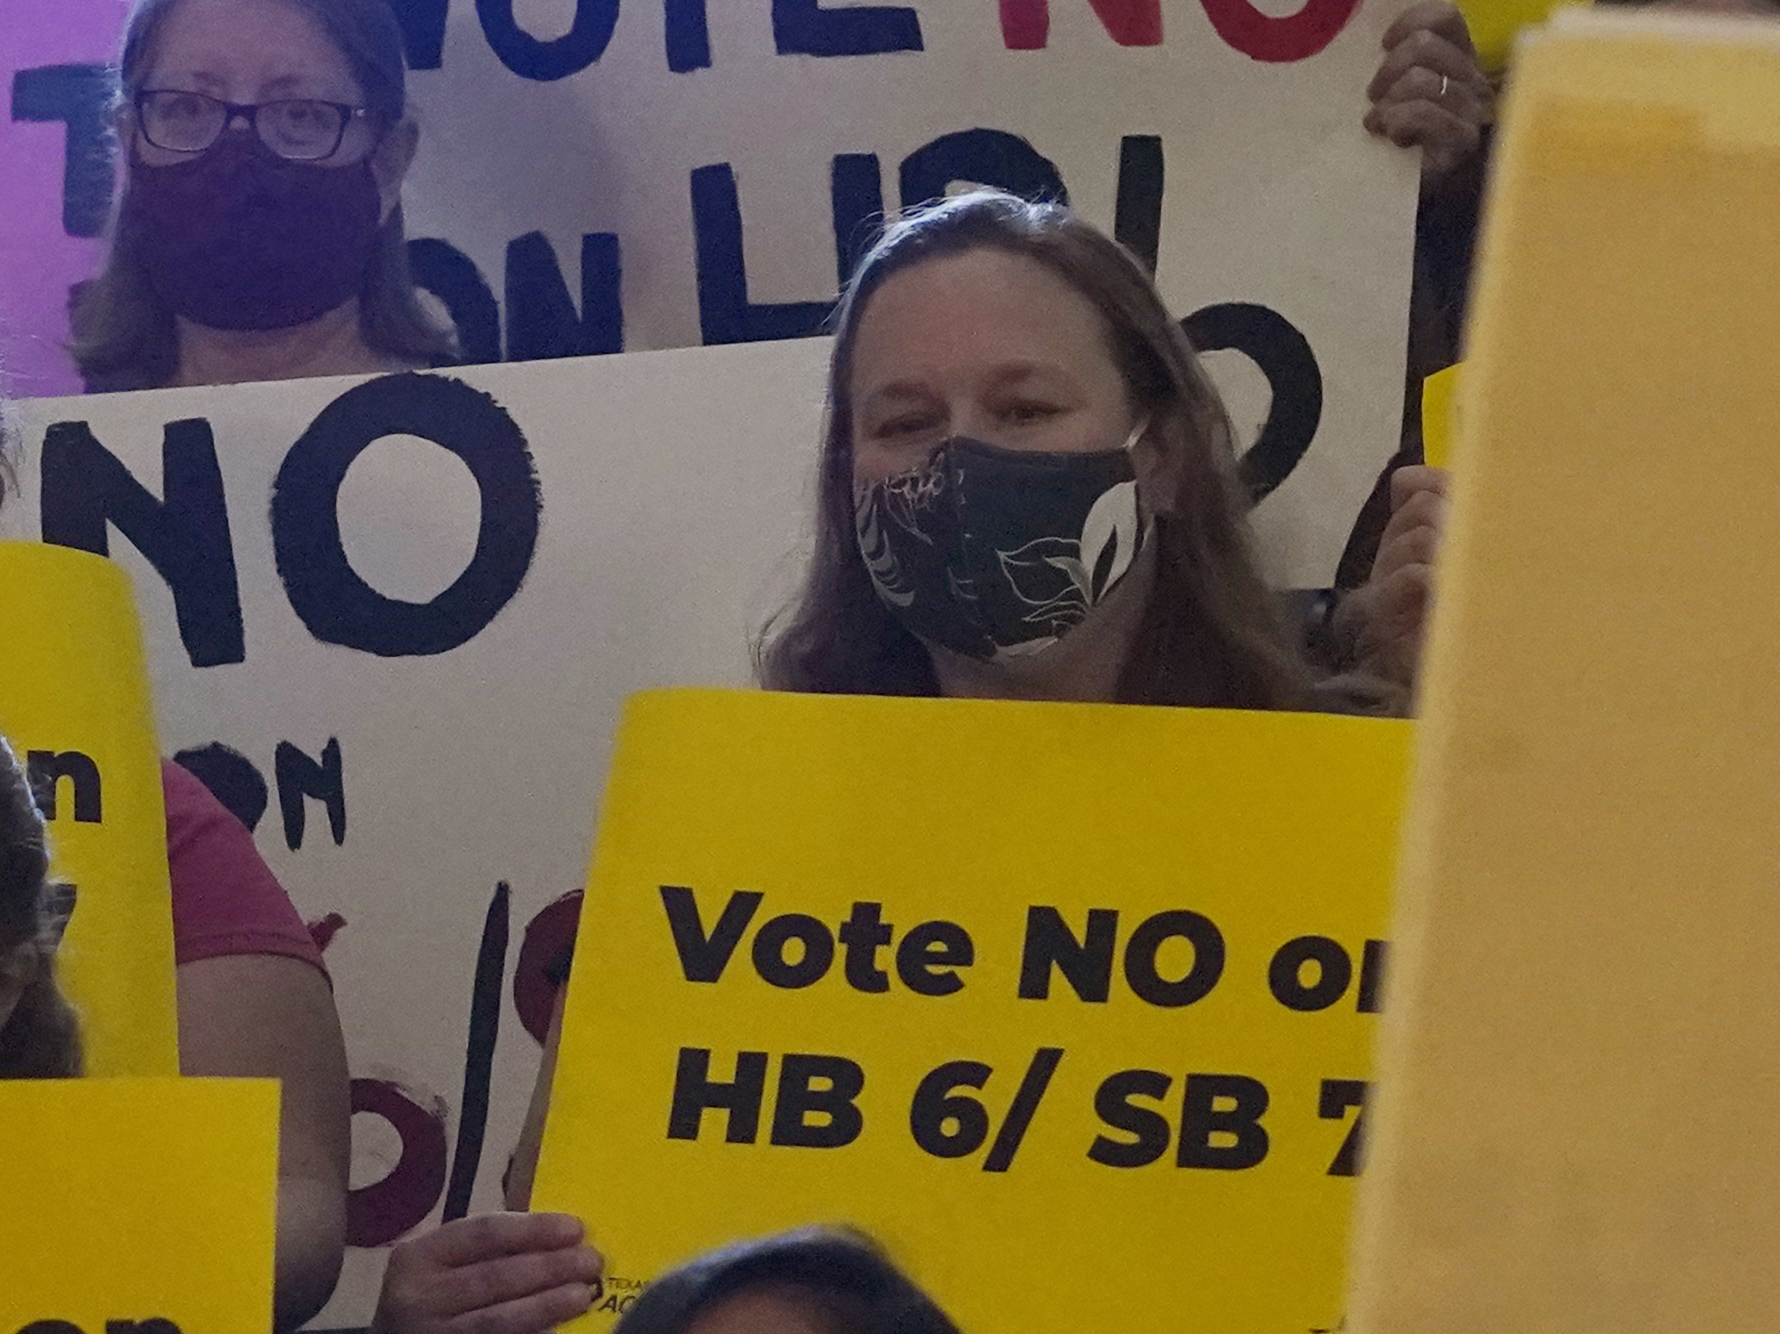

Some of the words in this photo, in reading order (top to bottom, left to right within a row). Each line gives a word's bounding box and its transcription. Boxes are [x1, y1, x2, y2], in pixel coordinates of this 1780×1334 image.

[40, 370, 542, 668] NO
[659, 886, 975, 998] Vote
[1019, 906, 1227, 1010] NO
[666, 1048, 868, 1151] HB
[910, 1047, 1065, 1174] 6/
[1087, 1070, 1272, 1172] SB
